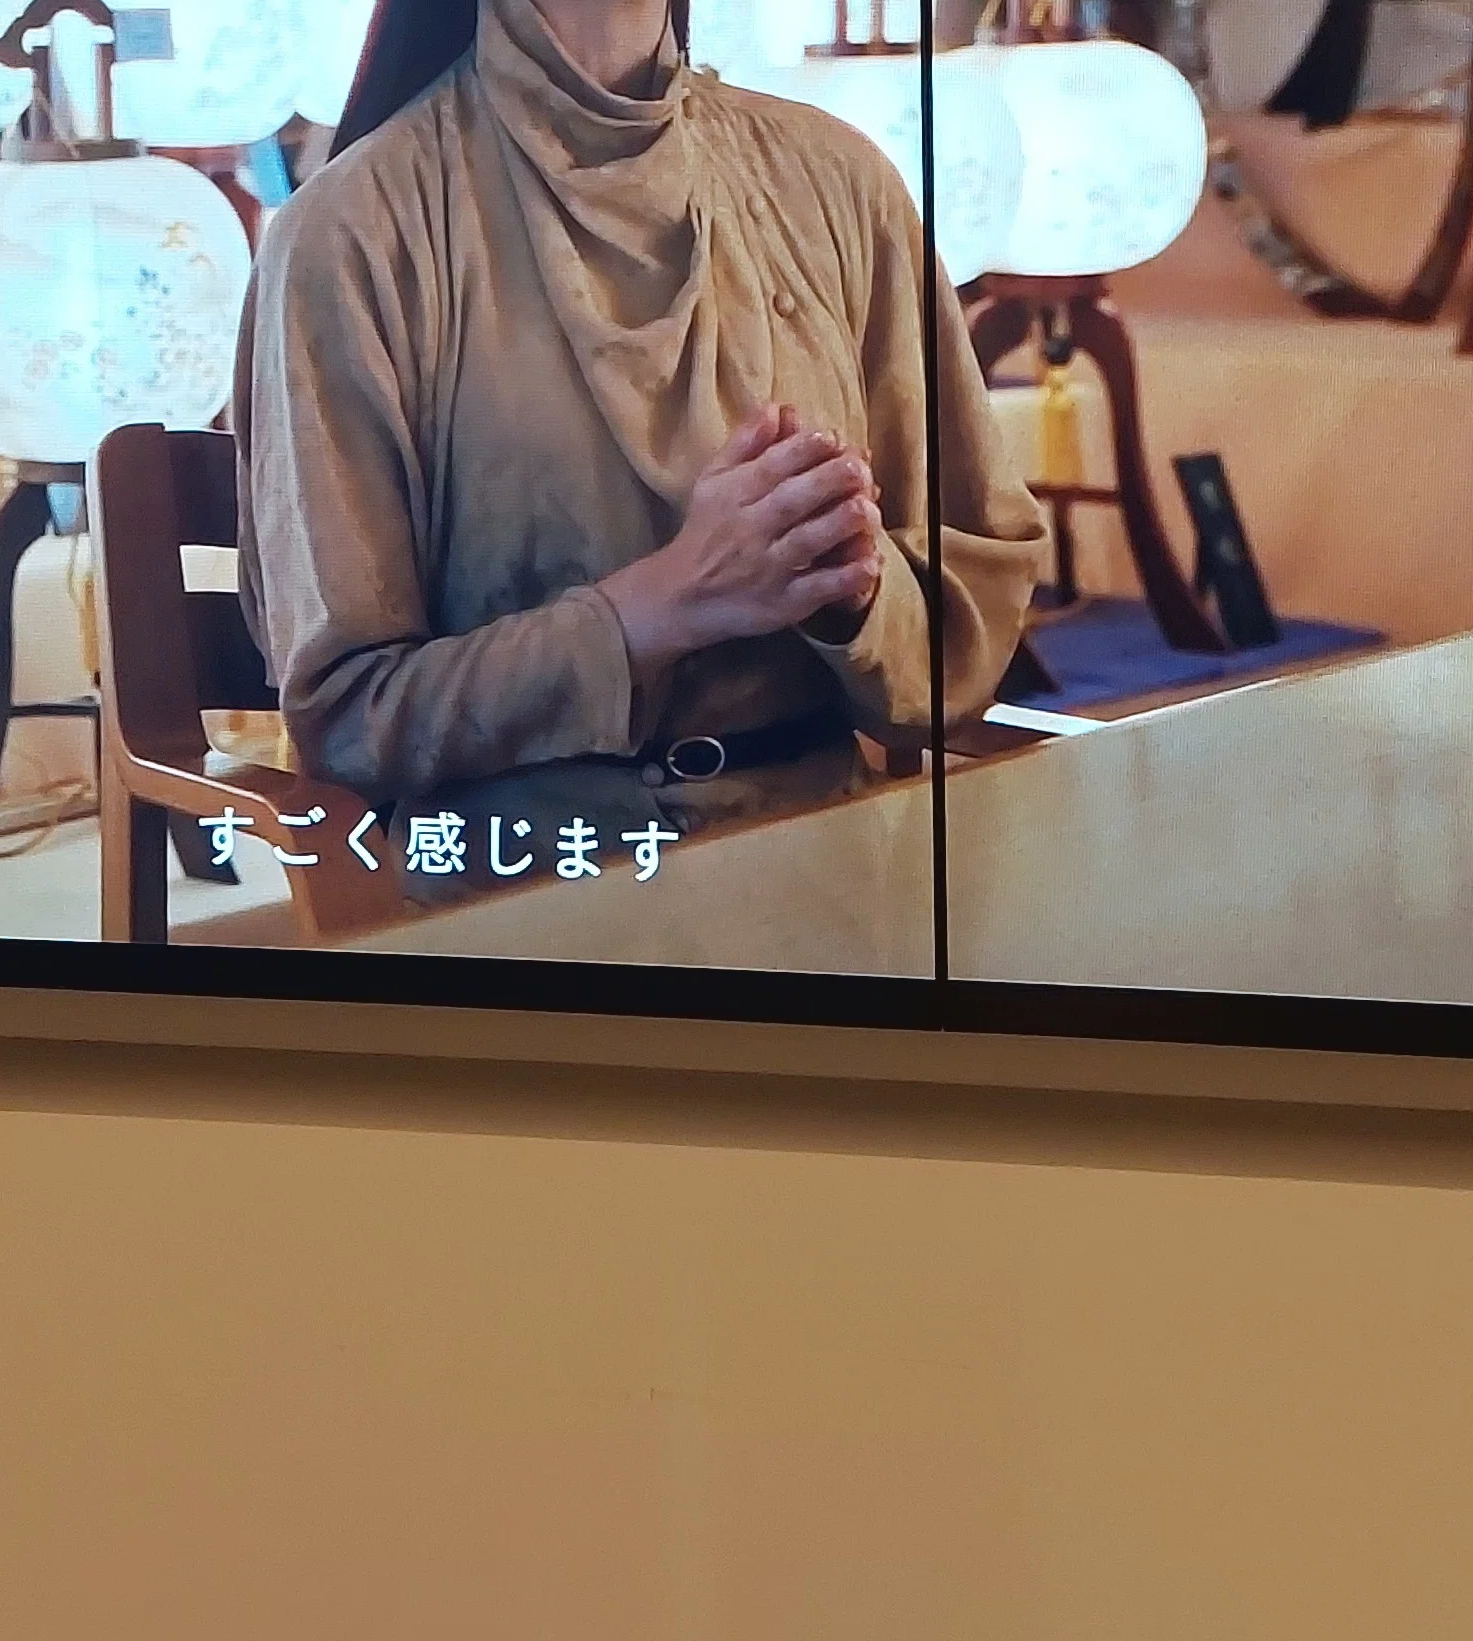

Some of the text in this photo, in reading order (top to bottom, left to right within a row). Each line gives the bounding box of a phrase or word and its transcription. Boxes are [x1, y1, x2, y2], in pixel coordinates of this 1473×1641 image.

[198, 806, 680, 882] すごく感じます
